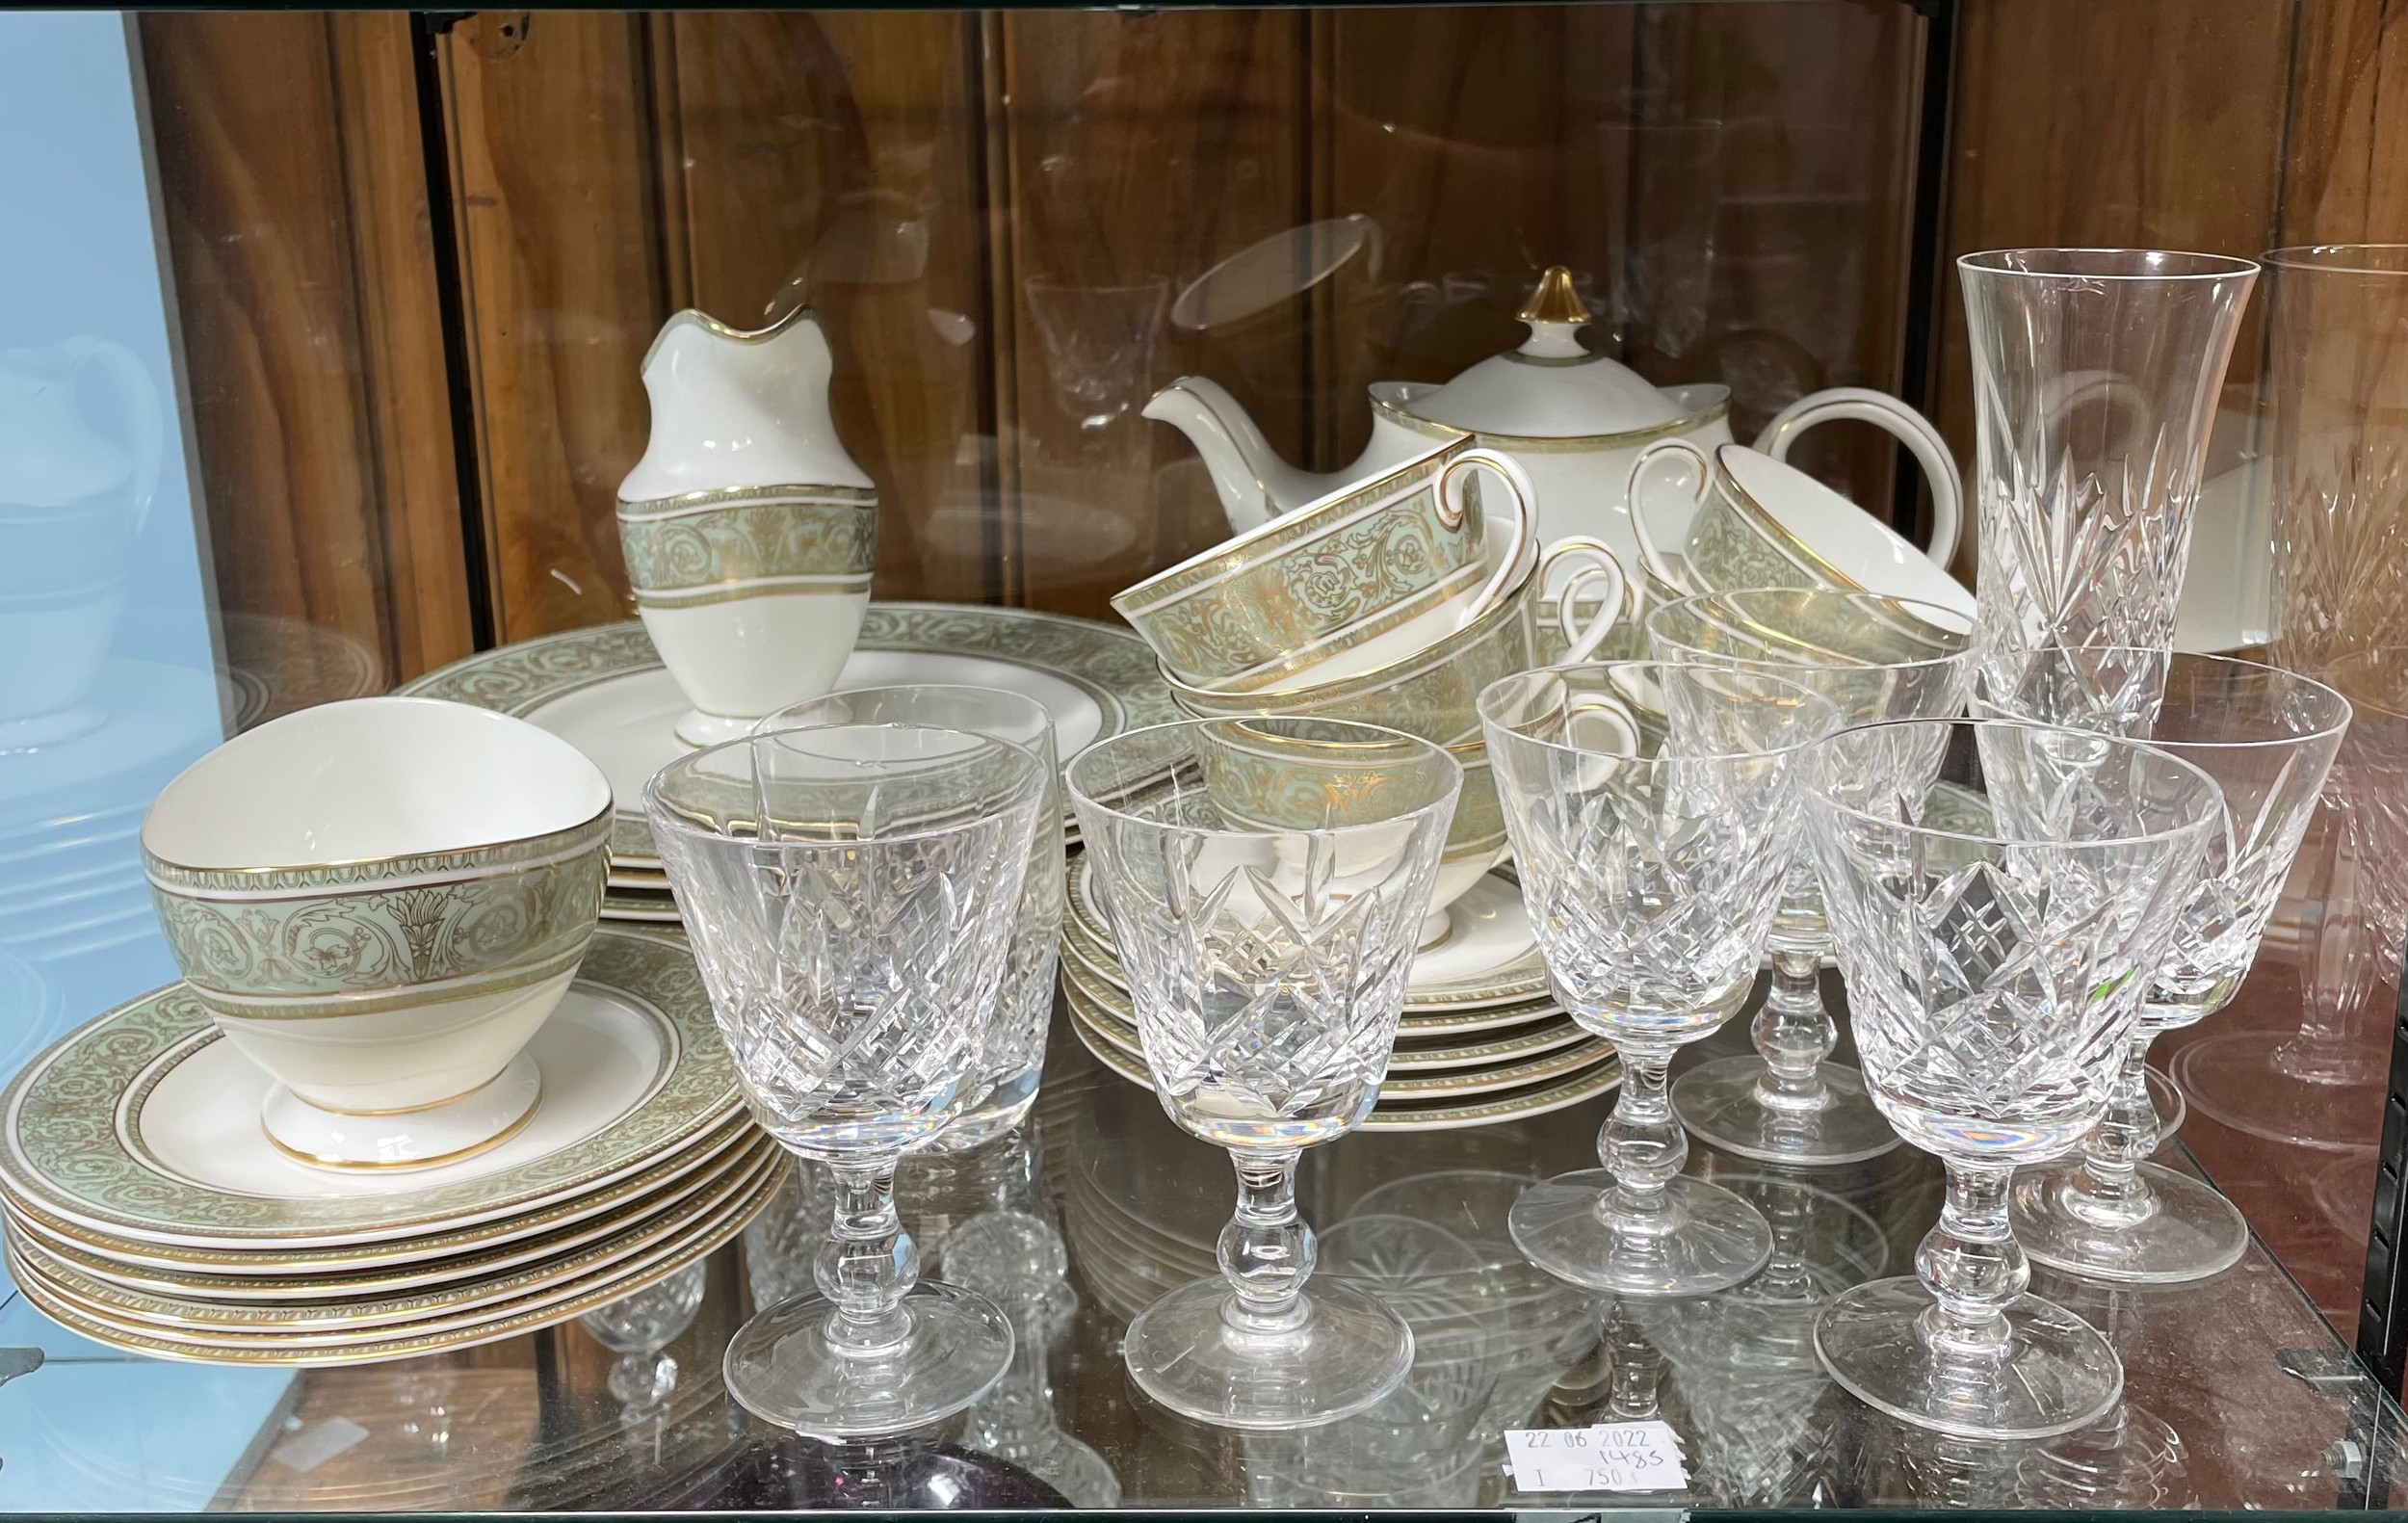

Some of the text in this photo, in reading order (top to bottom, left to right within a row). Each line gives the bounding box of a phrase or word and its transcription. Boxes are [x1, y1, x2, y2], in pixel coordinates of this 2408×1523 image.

[1525, 1430, 1650, 1448] 22 06 2022
[1599, 1450, 1663, 1469] 1485
